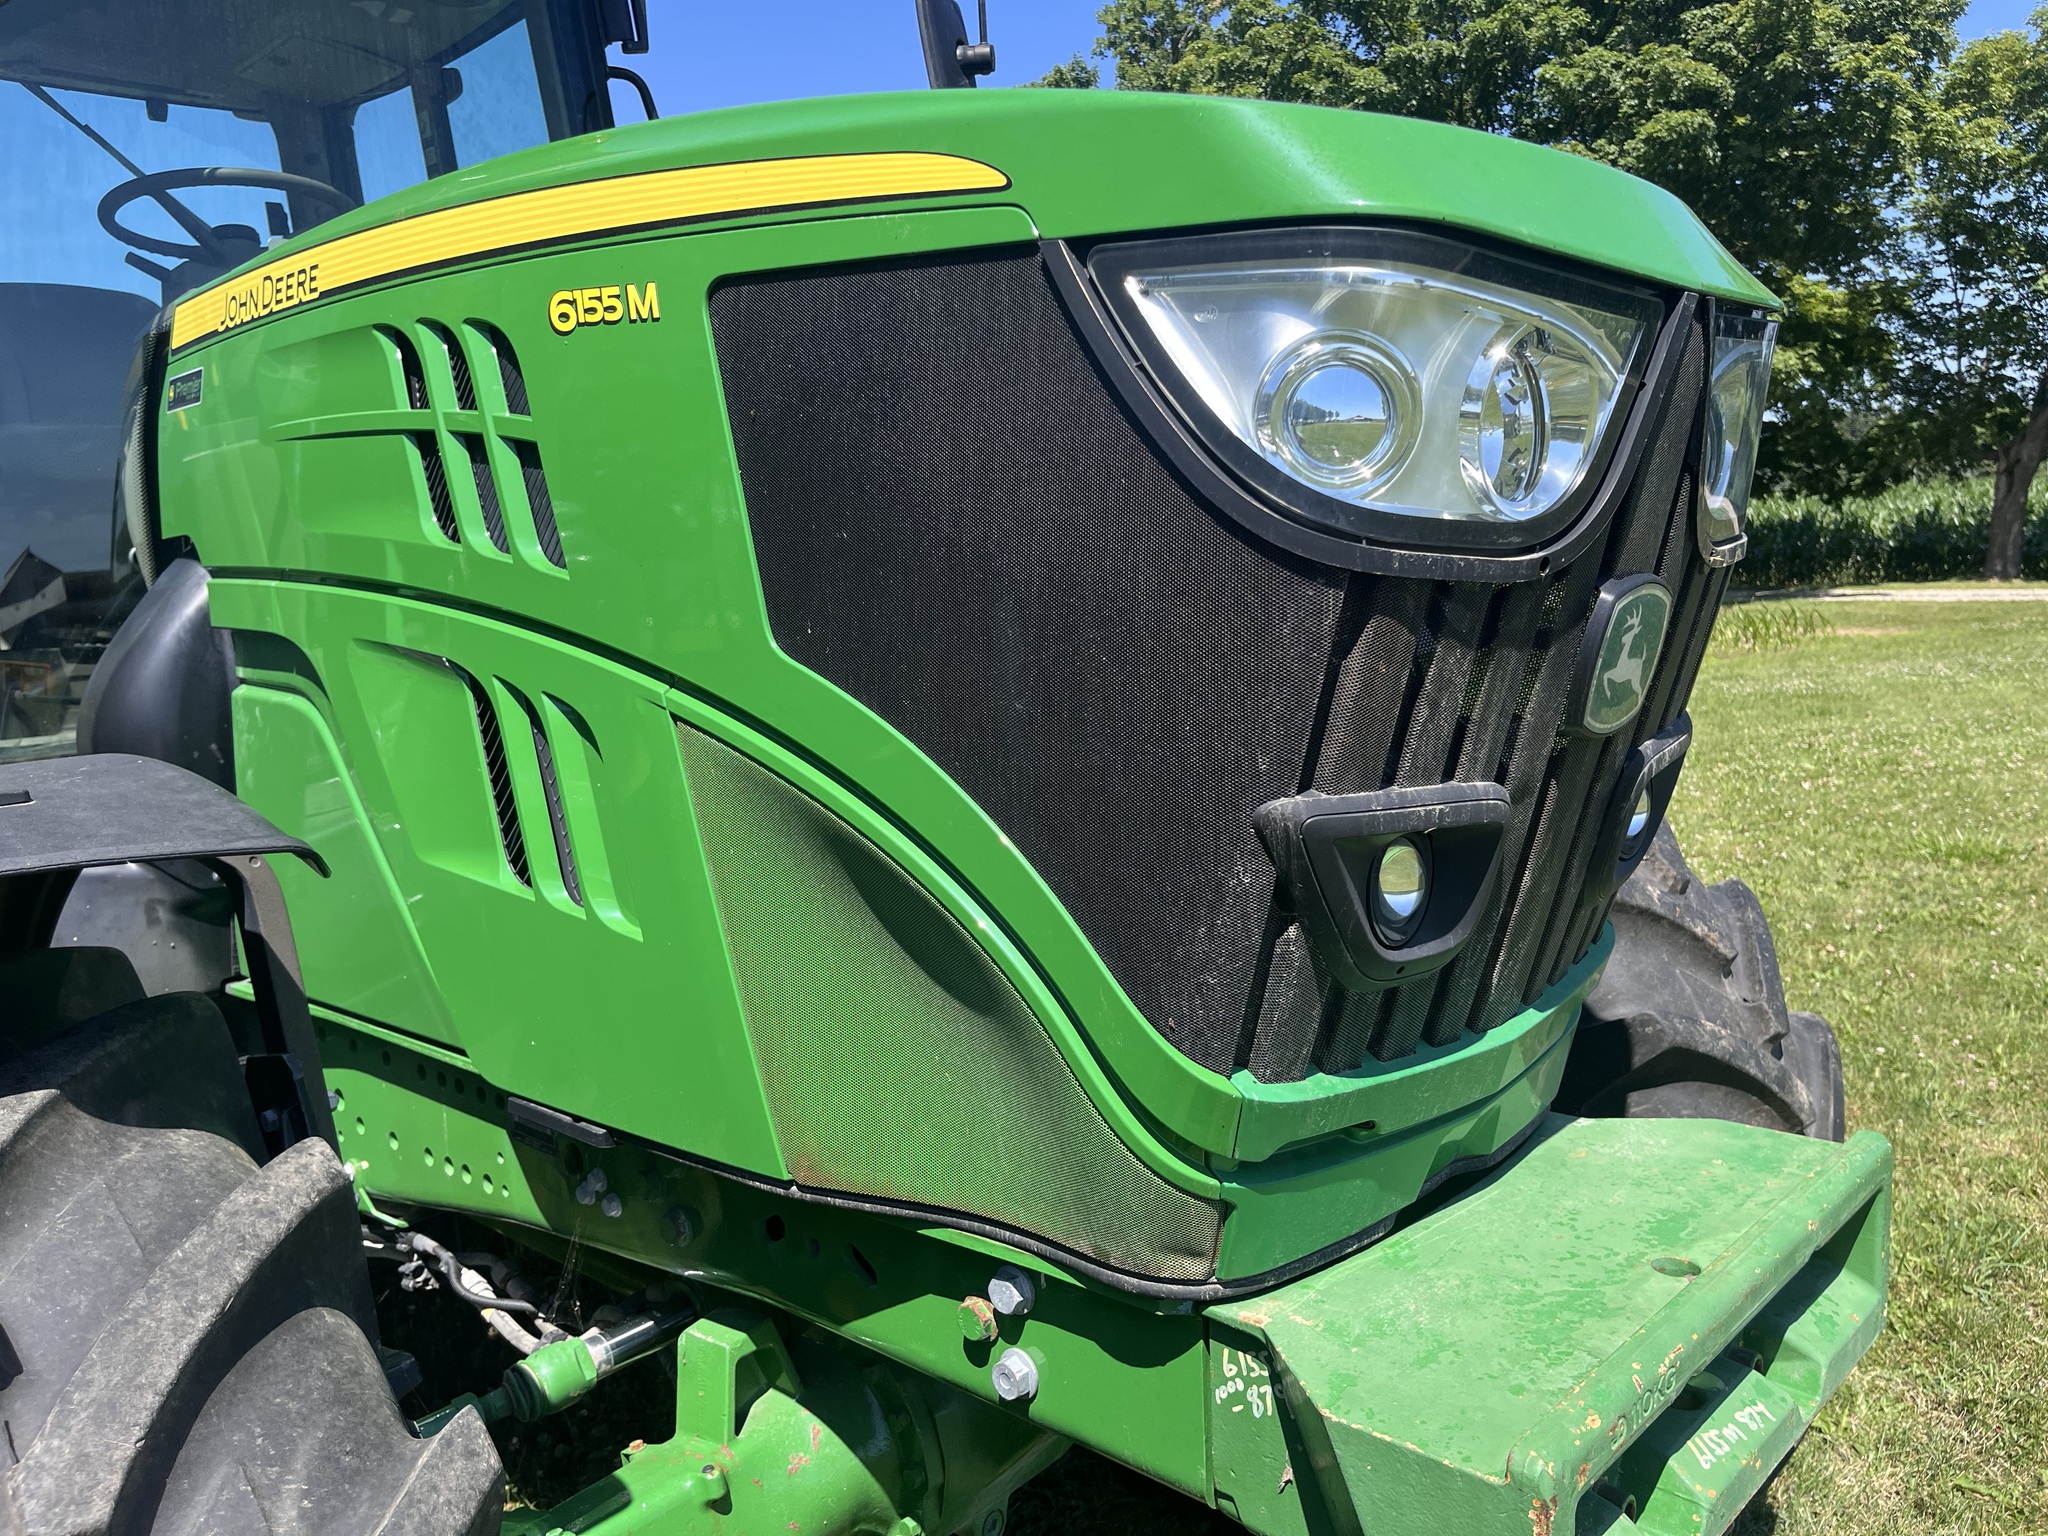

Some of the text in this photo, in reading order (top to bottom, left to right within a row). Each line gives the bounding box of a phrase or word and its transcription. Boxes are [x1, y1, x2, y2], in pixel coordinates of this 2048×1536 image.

[220, 264, 319, 327] JOHN DEERE
[548, 285, 624, 336] 6155
